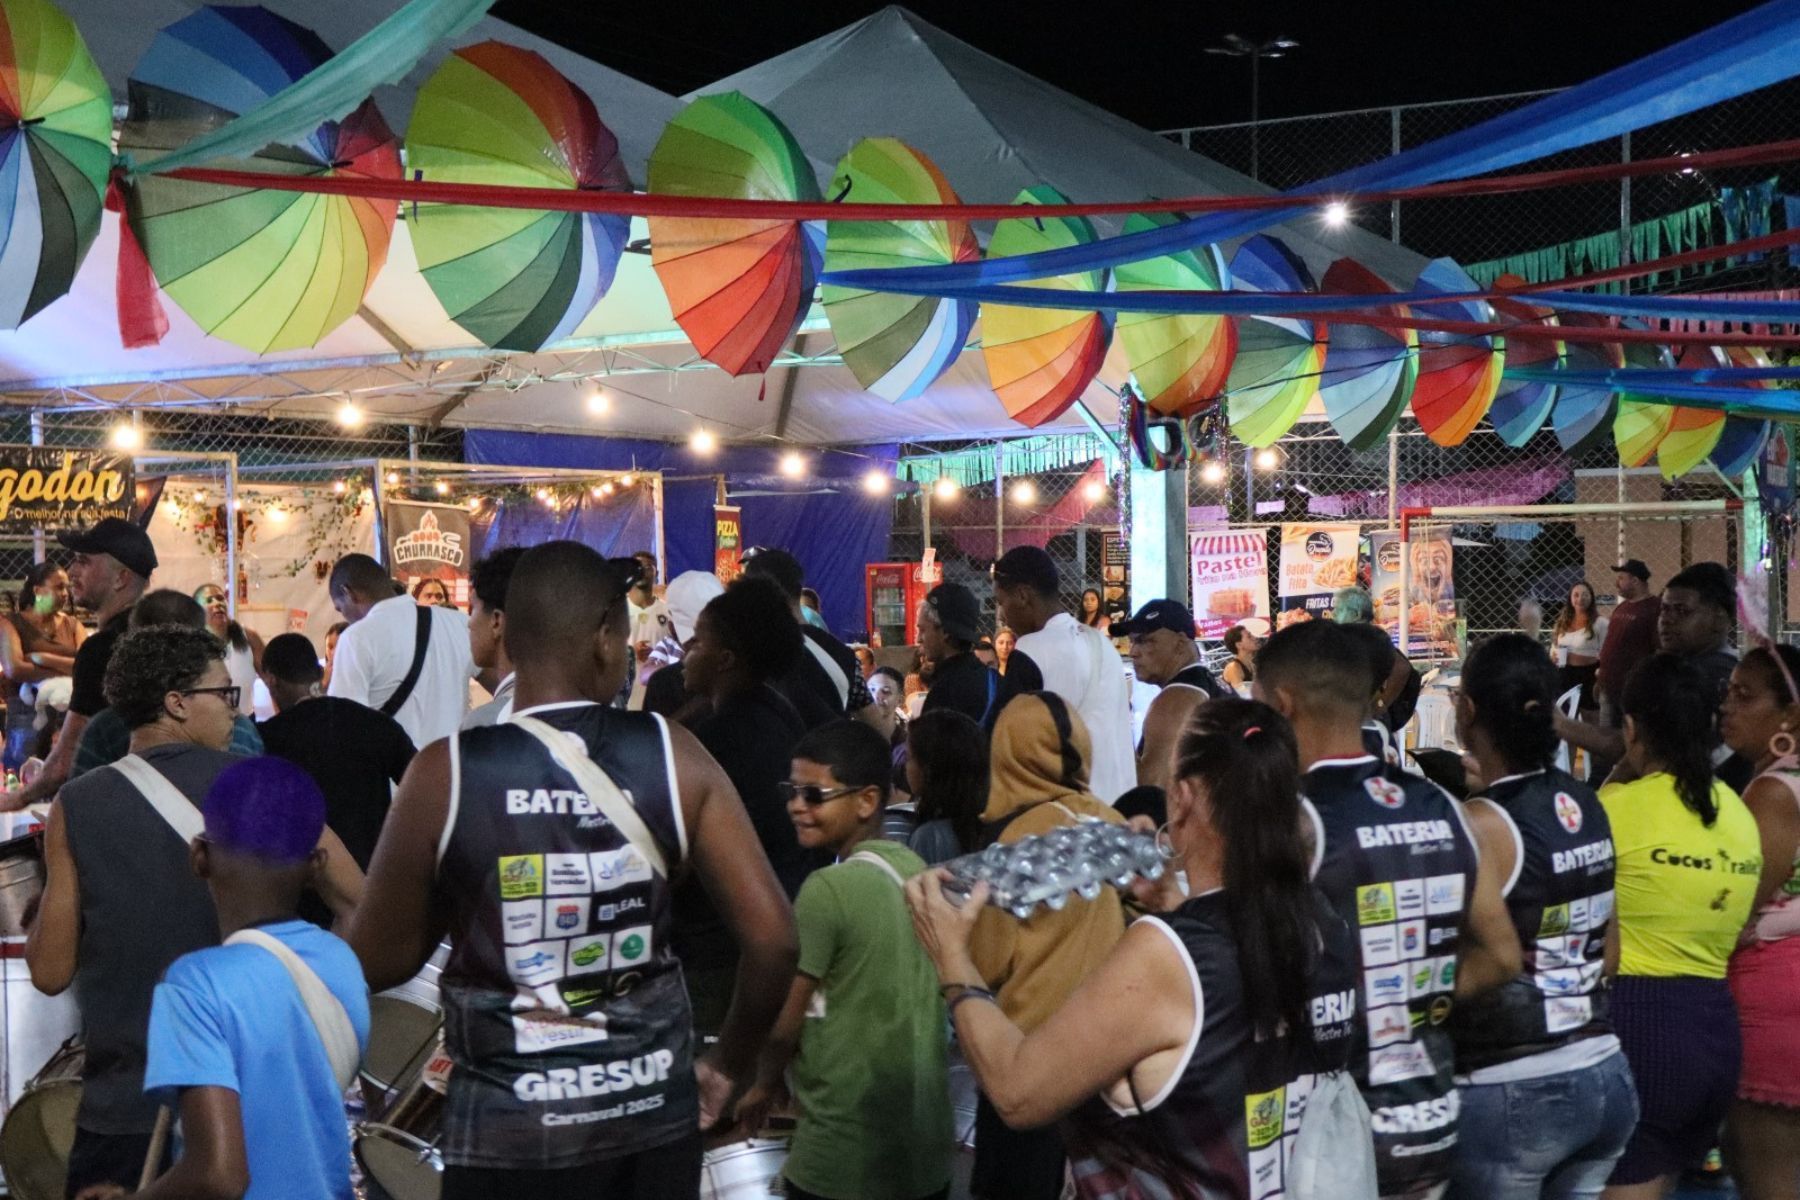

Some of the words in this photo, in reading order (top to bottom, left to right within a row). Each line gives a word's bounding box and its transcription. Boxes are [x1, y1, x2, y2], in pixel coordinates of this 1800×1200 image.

[717, 519, 738, 536] PIZZA
[396, 543, 463, 565] CHURRASCO
[1197, 552, 1262, 575] Pastel
[1306, 597, 1330, 609] FRITAS
[1356, 820, 1454, 848] BATERIA
[1552, 838, 1613, 874] BATERIA
[1651, 848, 1712, 870] Cocos
[513, 1049, 673, 1101] GRESUP
[541, 1105, 625, 1126] Carnaval
[627, 1094, 664, 1115] 2025
